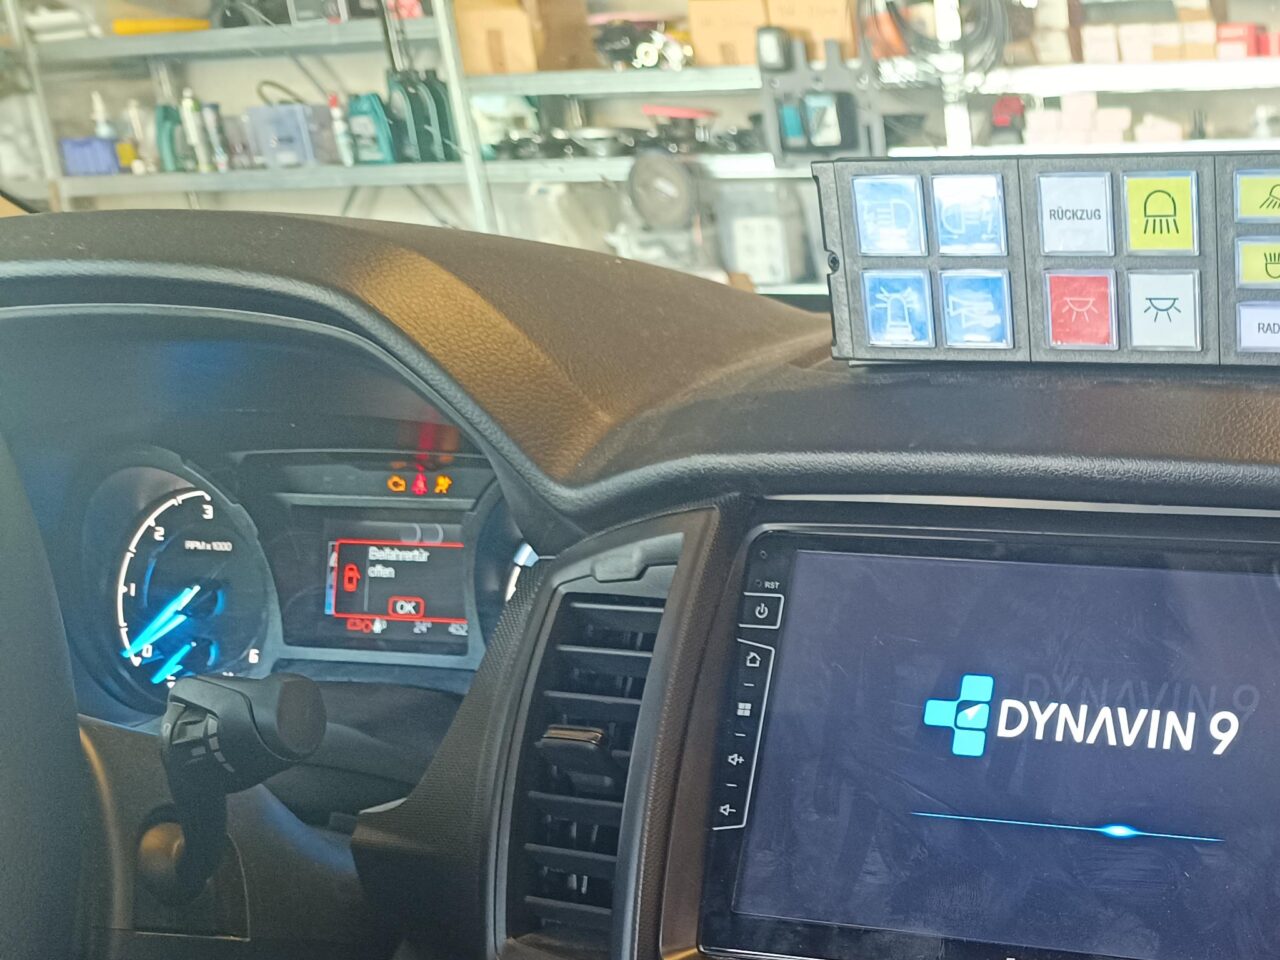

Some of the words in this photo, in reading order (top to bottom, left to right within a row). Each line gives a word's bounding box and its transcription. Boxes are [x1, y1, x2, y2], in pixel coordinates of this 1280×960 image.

[1049, 206, 1102, 221] RÜCKZUG
[202, 504, 214, 520] 3
[154, 526, 165, 541] 2
[129, 582, 136, 597] 1
[764, 581, 780, 589] RST
[395, 600, 416, 615] OK
[248, 648, 259, 664] 6
[996, 698, 1197, 751] DYNAVIN
[1209, 710, 1240, 755] 9
